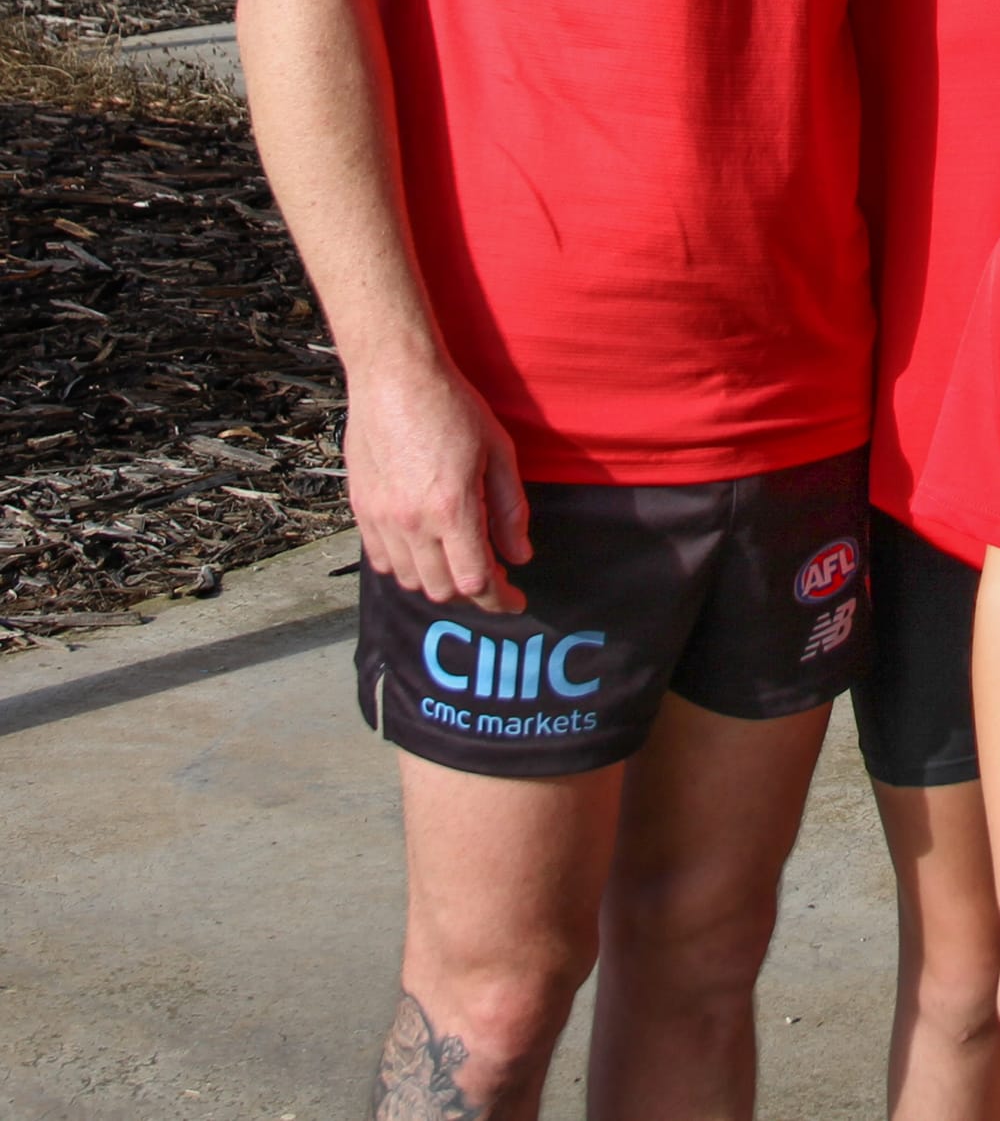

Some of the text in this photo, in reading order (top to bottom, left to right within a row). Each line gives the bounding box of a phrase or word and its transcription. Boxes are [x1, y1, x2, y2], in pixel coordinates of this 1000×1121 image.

[801, 547, 856, 598] AFL
[421, 696, 598, 736] cmc markets
